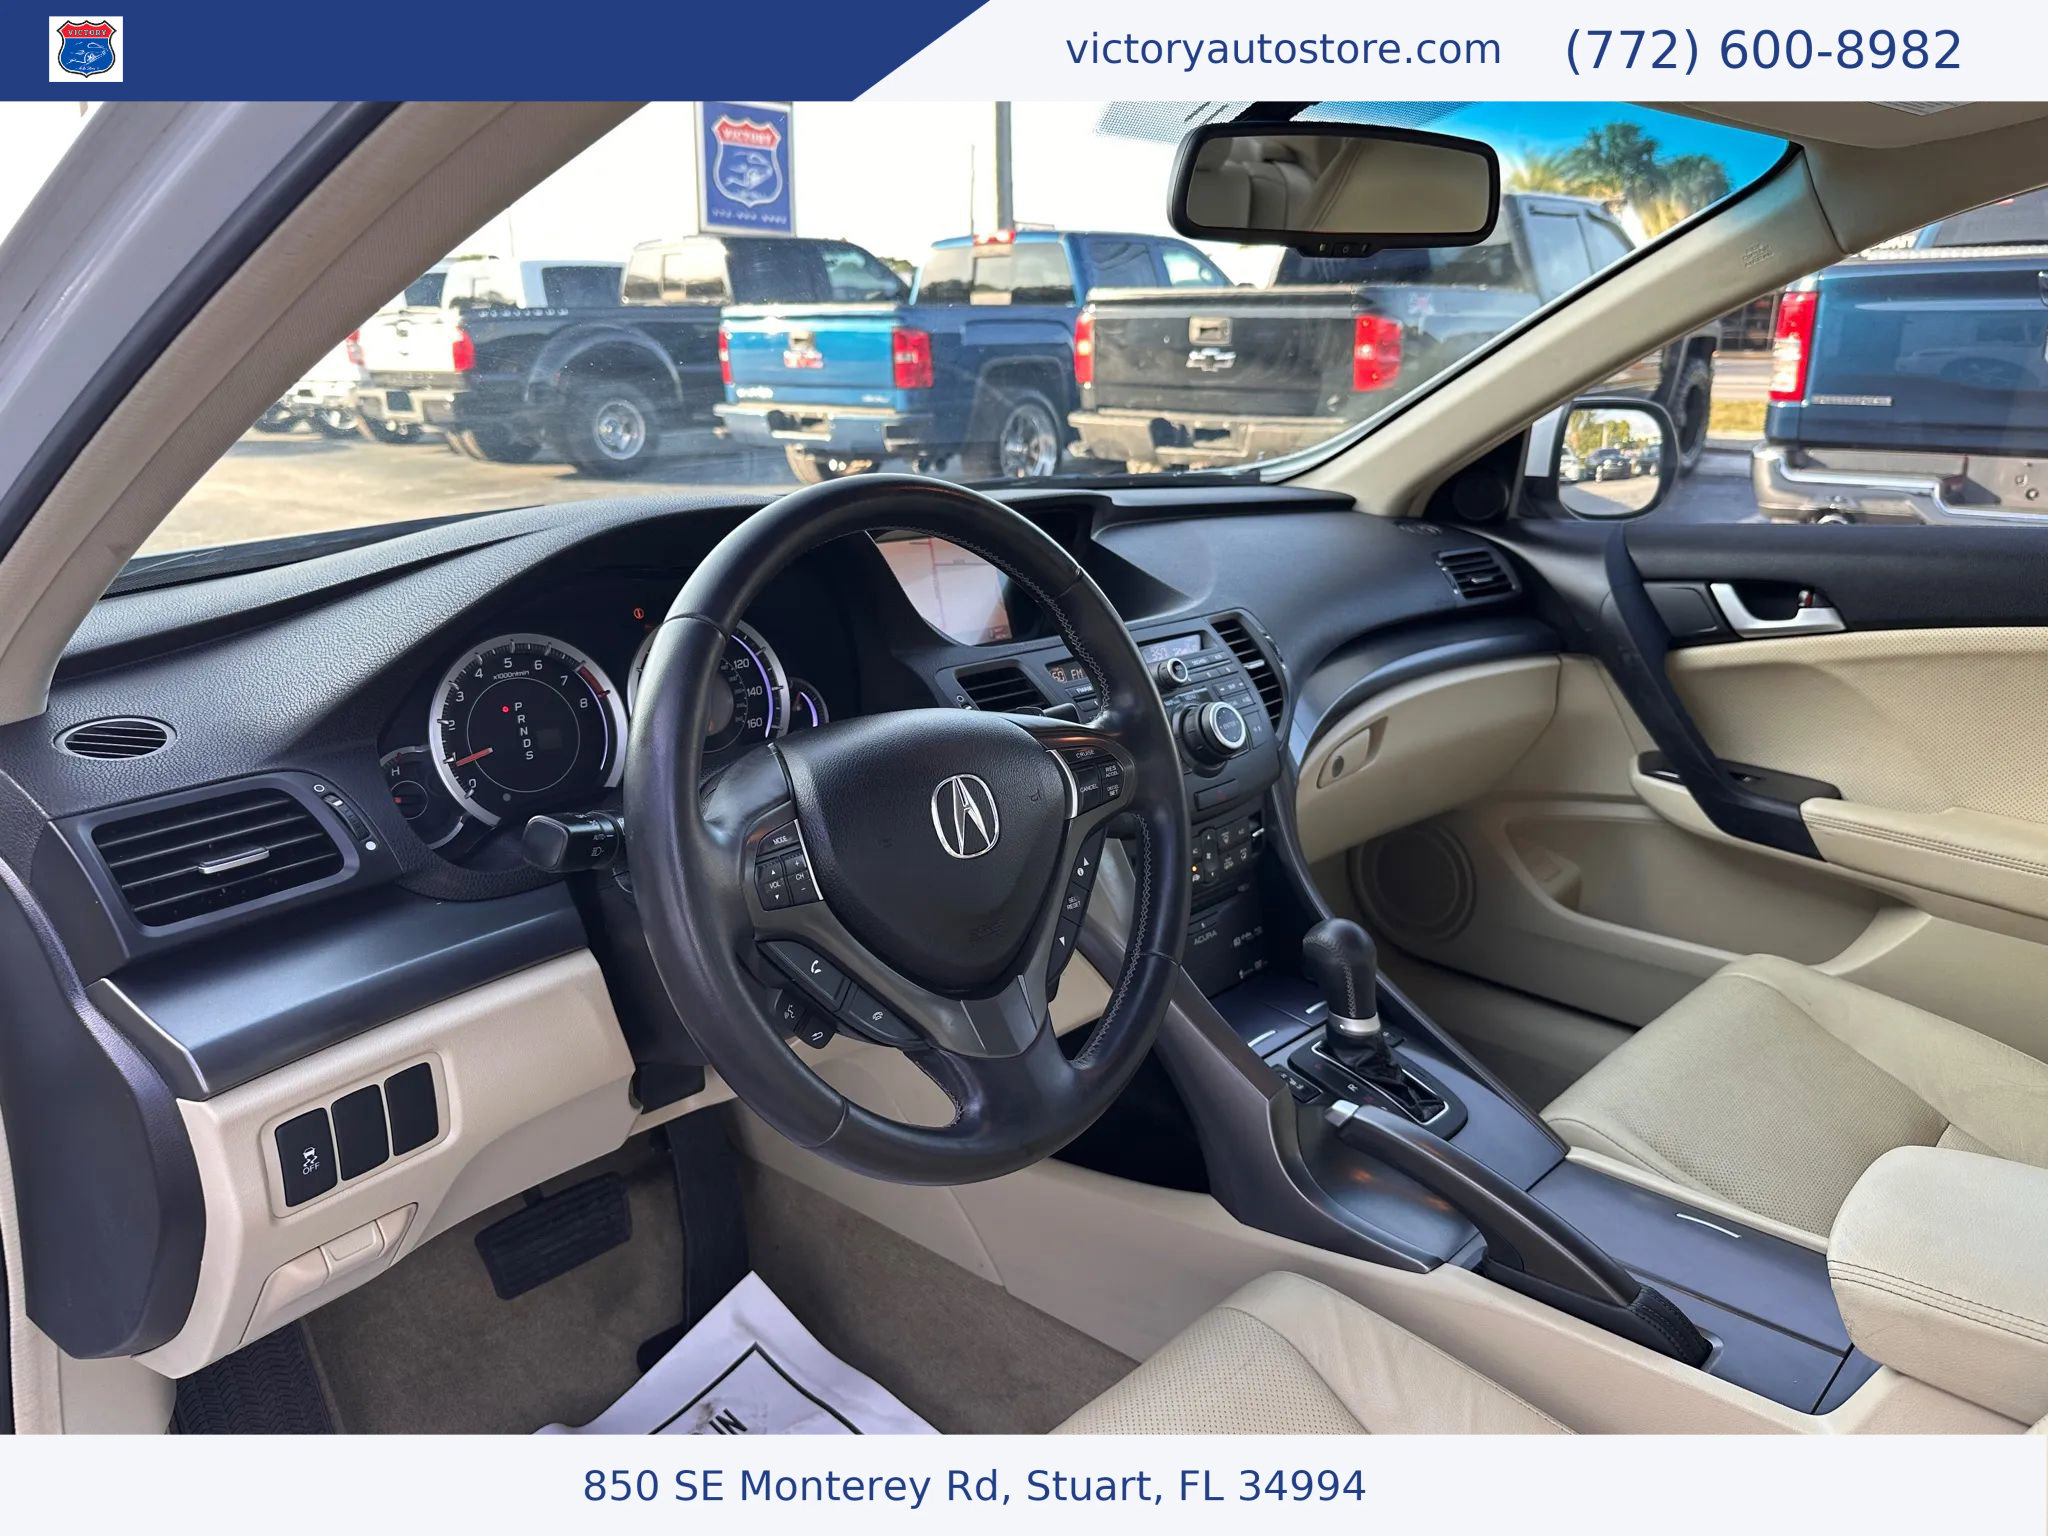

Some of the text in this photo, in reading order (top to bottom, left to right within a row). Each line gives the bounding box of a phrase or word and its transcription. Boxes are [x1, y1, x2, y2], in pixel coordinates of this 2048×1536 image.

[503, 657, 513, 668] 5
[534, 659, 543, 670] 6
[734, 658, 750, 669] 120
[475, 668, 484, 679] 4
[560, 675, 569, 686] 7
[456, 691, 465, 702] 3
[747, 685, 763, 697] 140
[514, 702, 523, 711] P
[580, 697, 588, 709] 8
[517, 714, 526, 724] R
[747, 717, 763, 729] 160
[448, 719, 456, 731] 2
[520, 726, 528, 736] N
[523, 738, 531, 748] D
[525, 750, 534, 760] S
[1075, 749, 1095, 759] CRUISE
[391, 766, 400, 776] H
[1105, 764, 1117, 772] RES
[468, 778, 477, 789] 0
[1080, 783, 1099, 793] CANCEL
[772, 835, 788, 845] MODE
[795, 872, 805, 881] CH
[769, 880, 781, 889] VOL
[1193, 929, 1217, 946] ACURA
[302, 1161, 320, 1176] OFF
